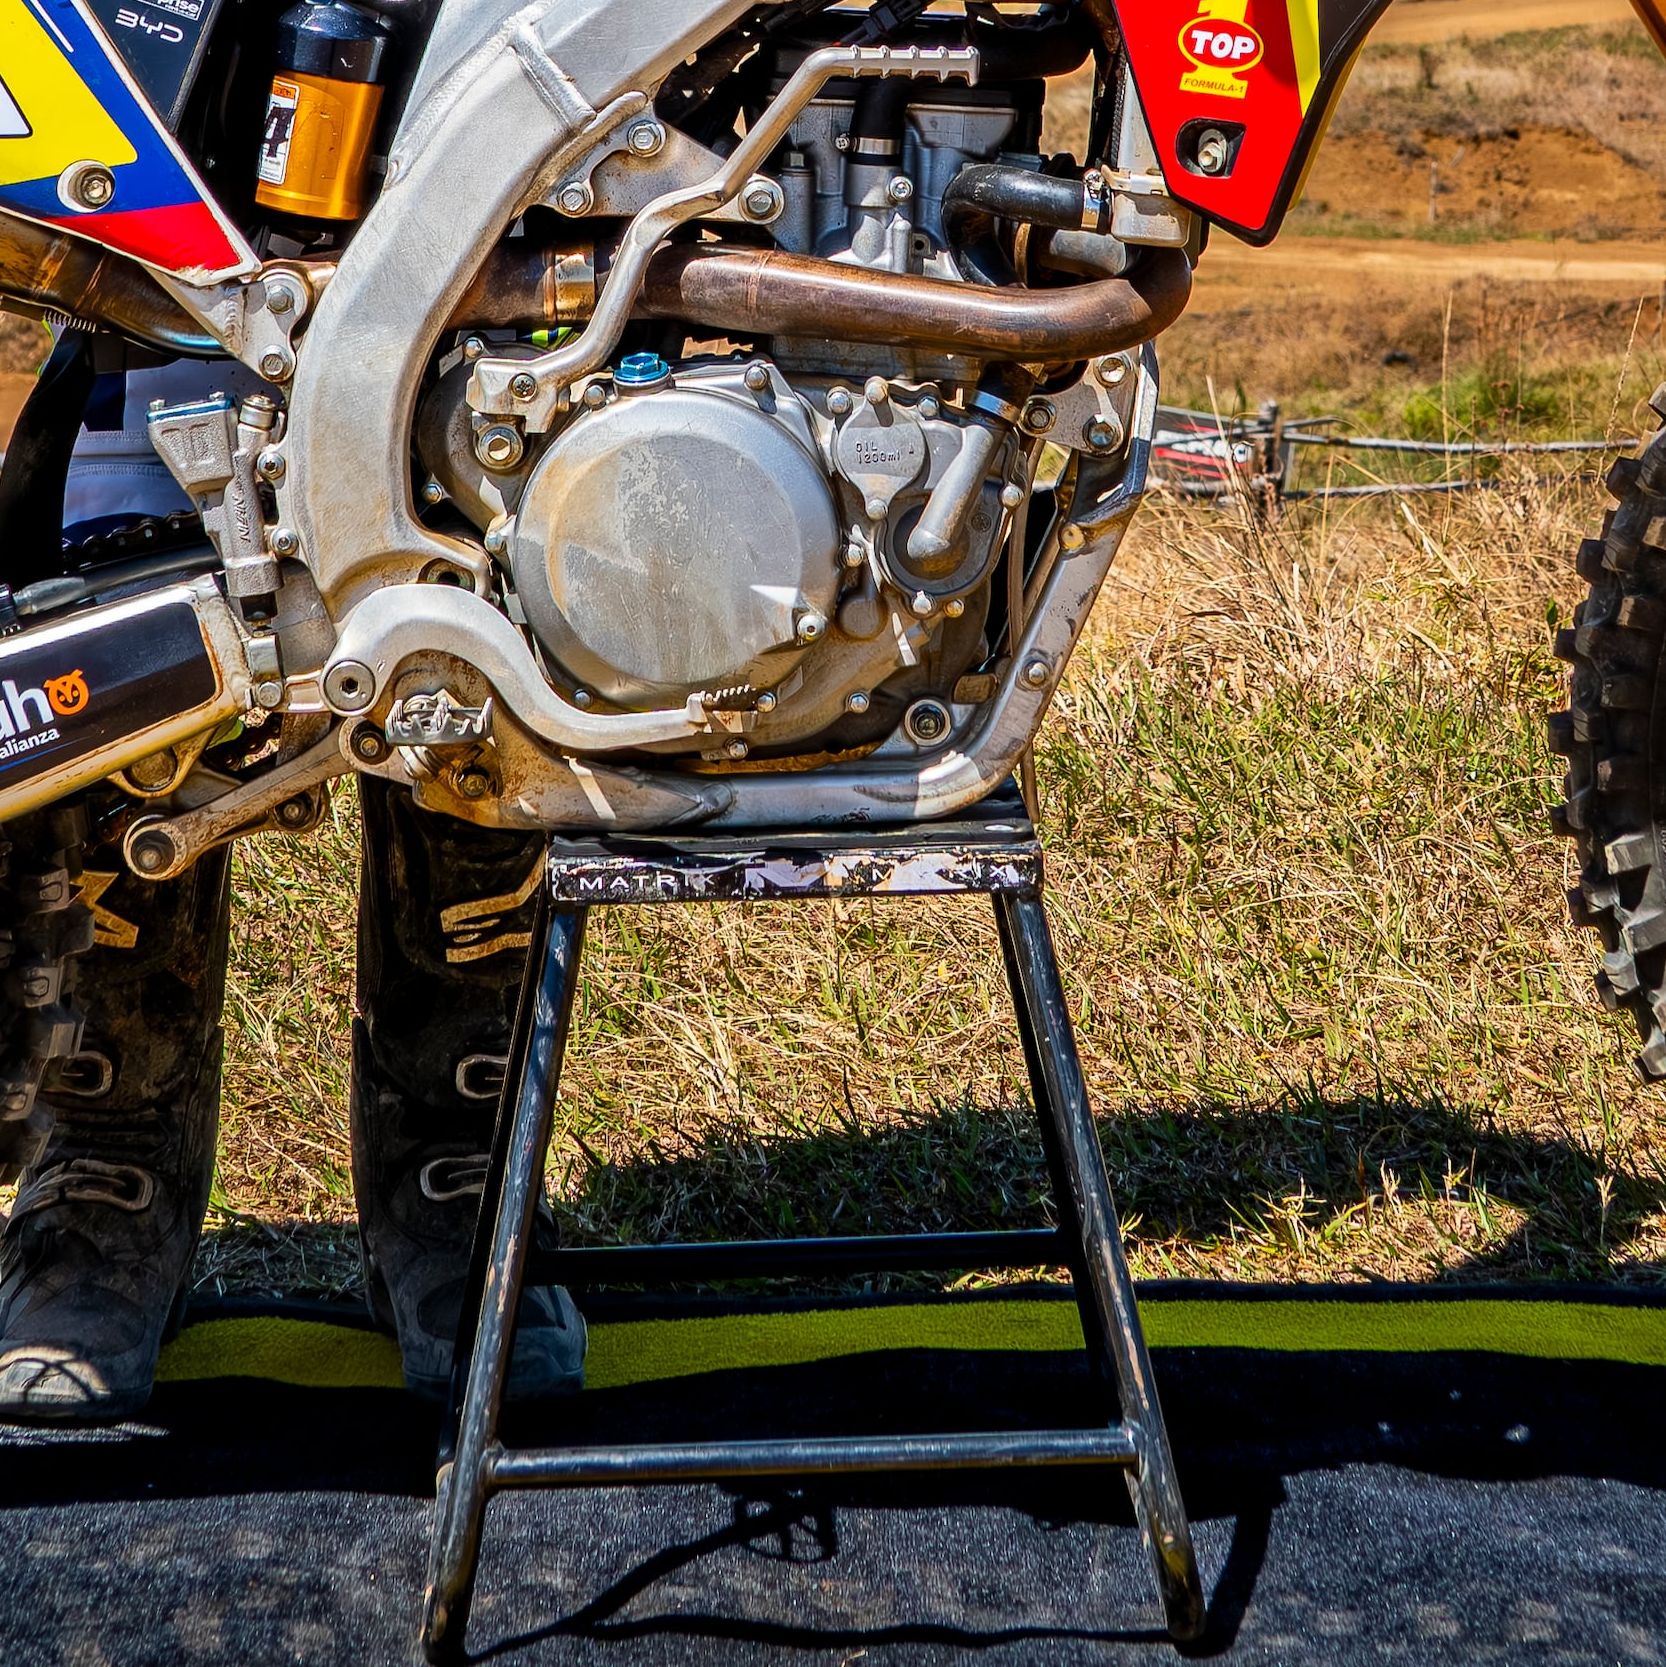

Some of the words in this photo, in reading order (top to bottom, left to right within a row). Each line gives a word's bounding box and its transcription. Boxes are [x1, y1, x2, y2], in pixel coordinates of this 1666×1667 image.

[114, 8, 184, 43] BYD
[1190, 29, 1256, 60] TOP
[1183, 77, 1245, 93] FORMULA-1
[856, 441, 878, 453] OIL
[578, 873, 716, 891] MATRIX
